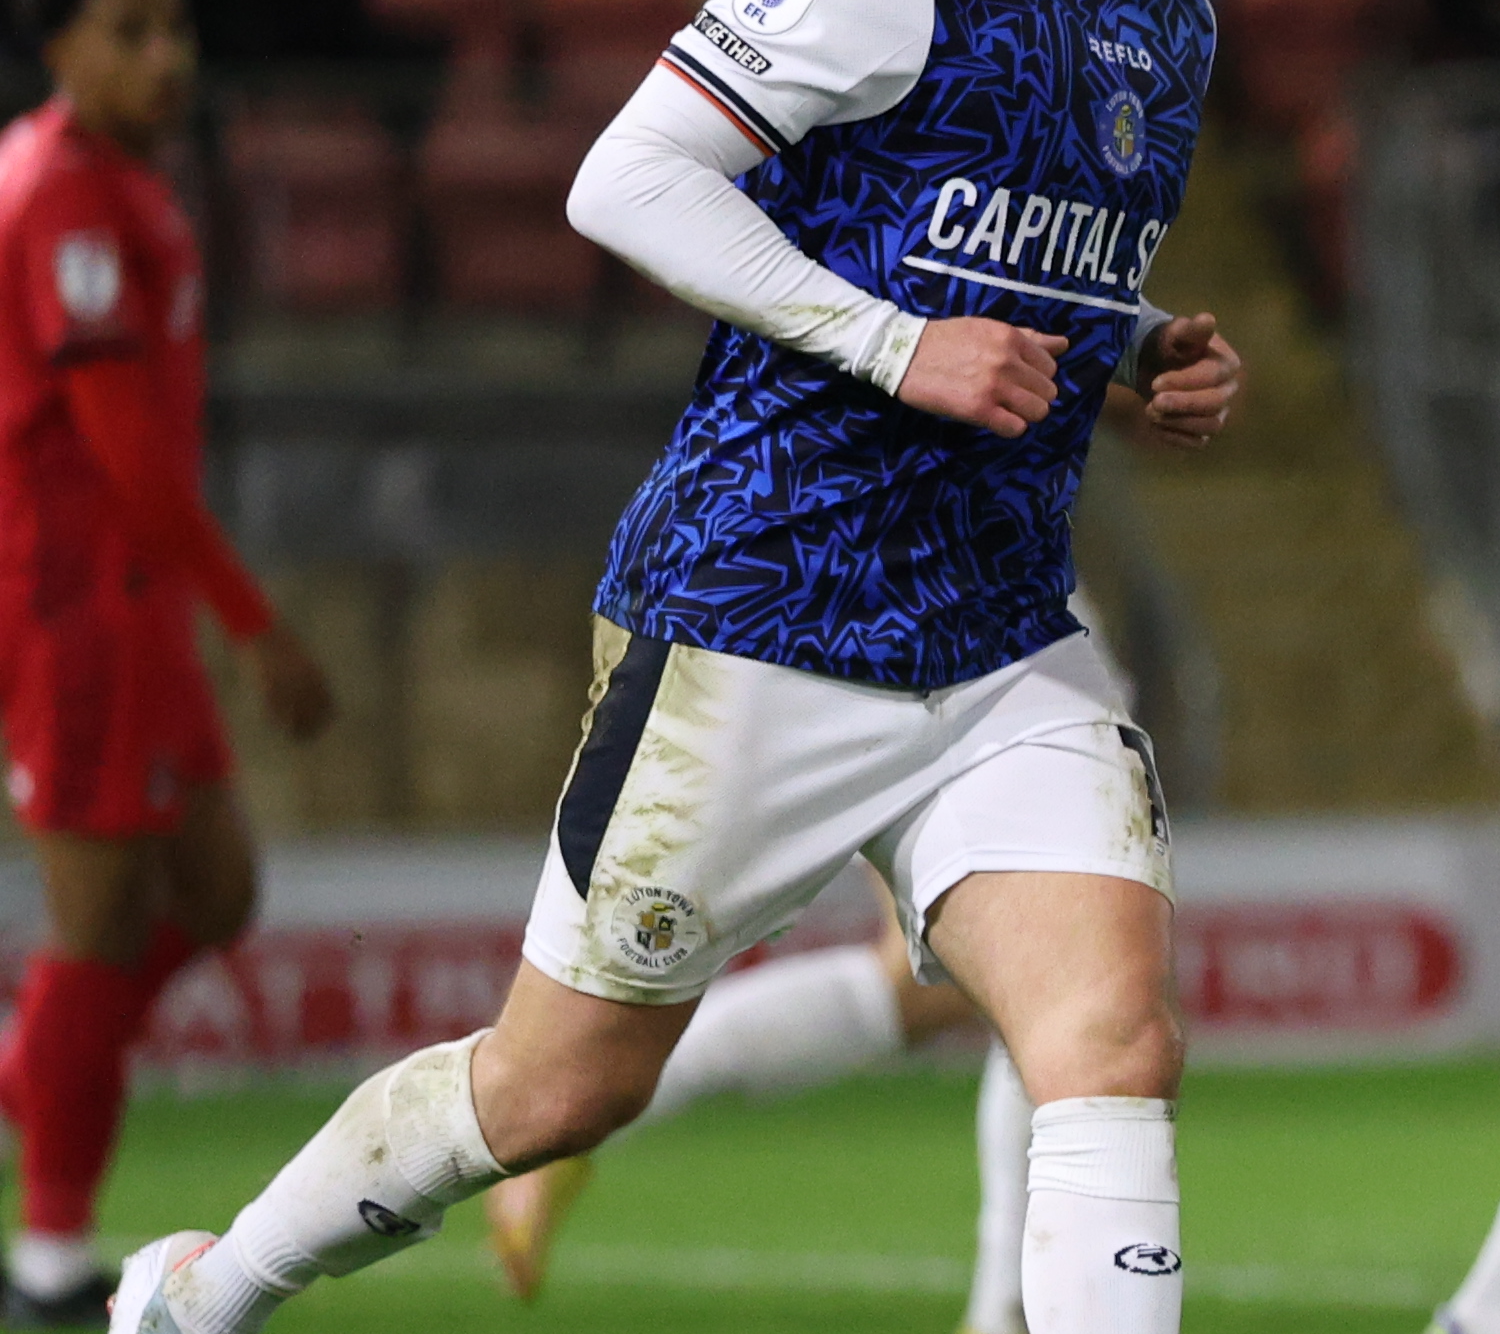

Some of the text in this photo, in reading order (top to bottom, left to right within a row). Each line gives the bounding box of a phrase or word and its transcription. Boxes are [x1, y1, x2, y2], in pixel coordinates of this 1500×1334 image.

[743, 2, 770, 26] EFL
[1088, 36, 1152, 72] REFLO
[927, 177, 1126, 284] CAPITAL
[625, 887, 695, 918] LUTON TOWN
[617, 937, 660, 967] FOOTBALL
